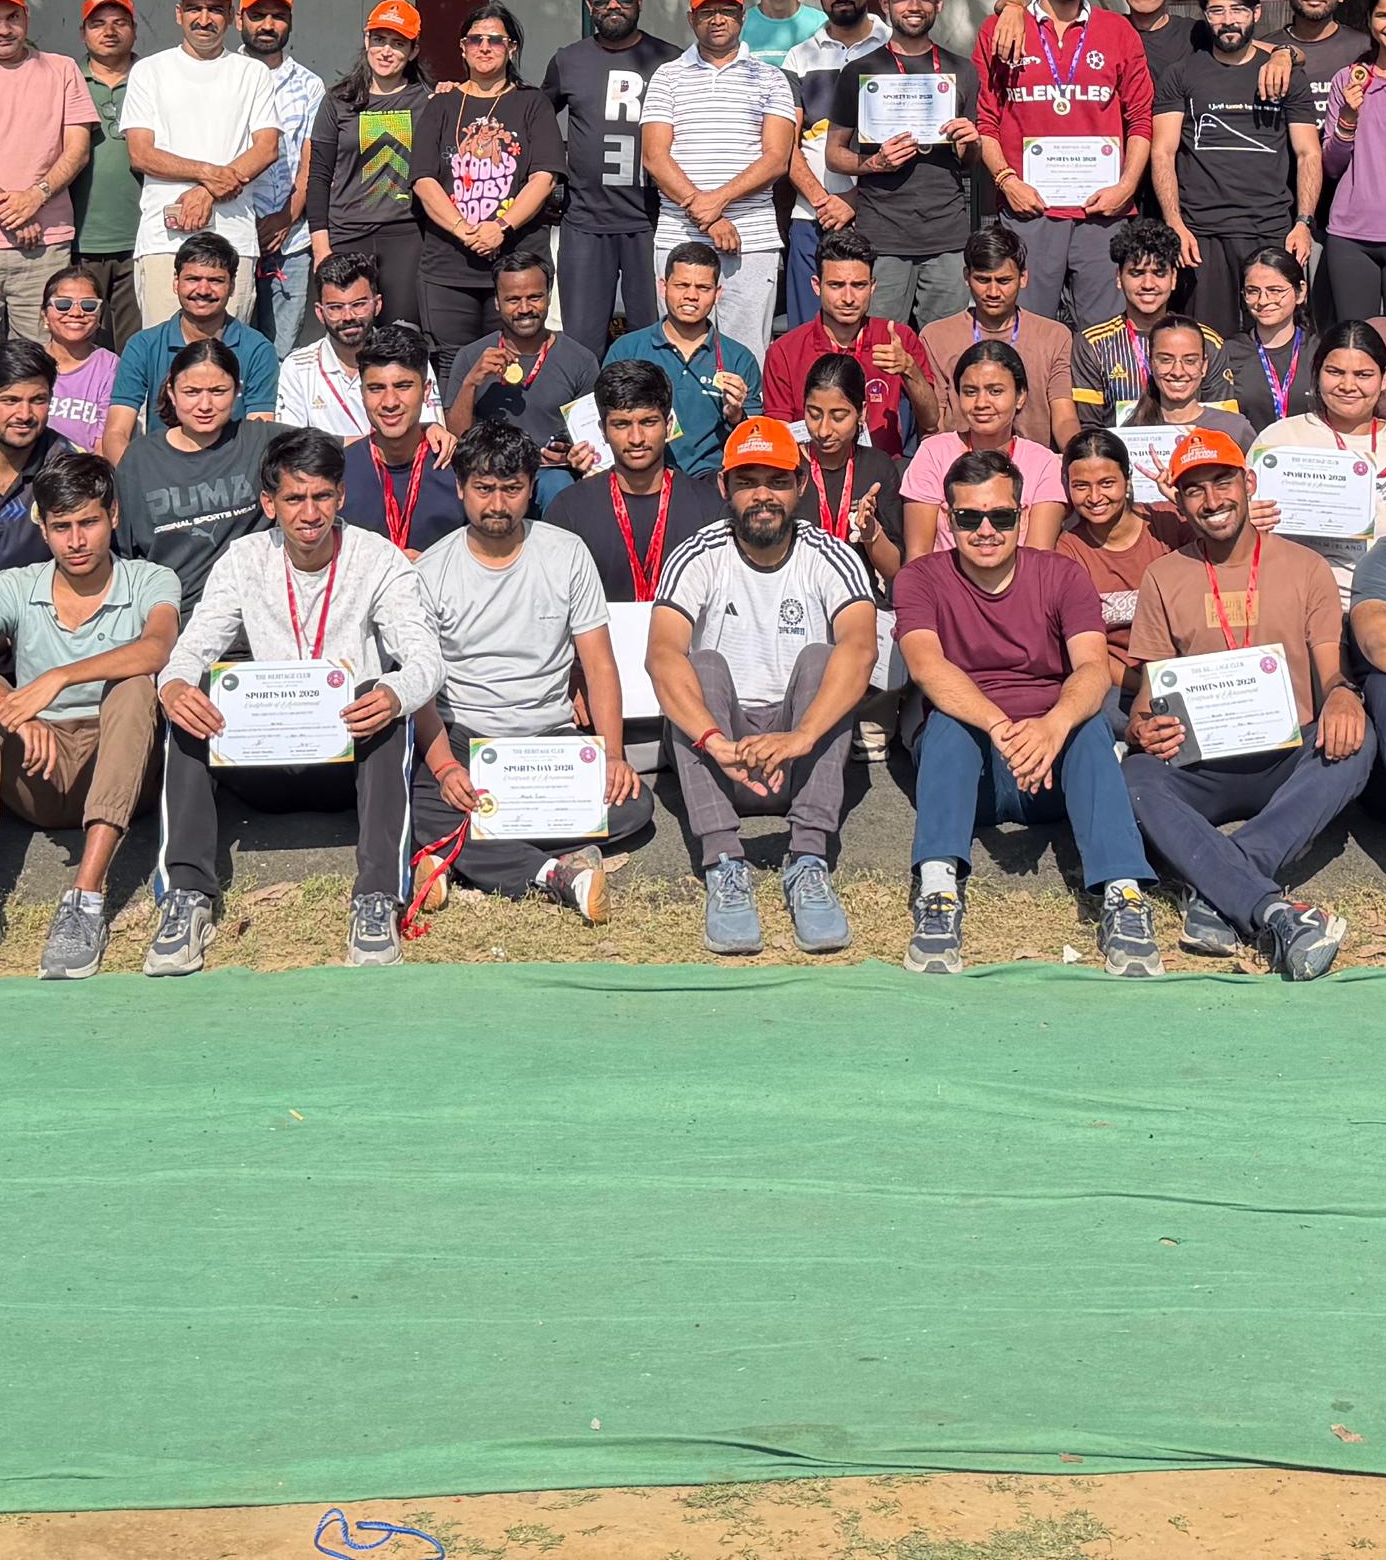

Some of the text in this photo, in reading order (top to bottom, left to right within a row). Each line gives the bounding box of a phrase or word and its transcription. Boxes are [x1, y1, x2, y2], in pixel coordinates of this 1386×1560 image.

[1006, 85, 1113, 103] RELENTLES
[146, 474, 256, 524] PUMA
[193, 510, 233, 525] SPORTS
